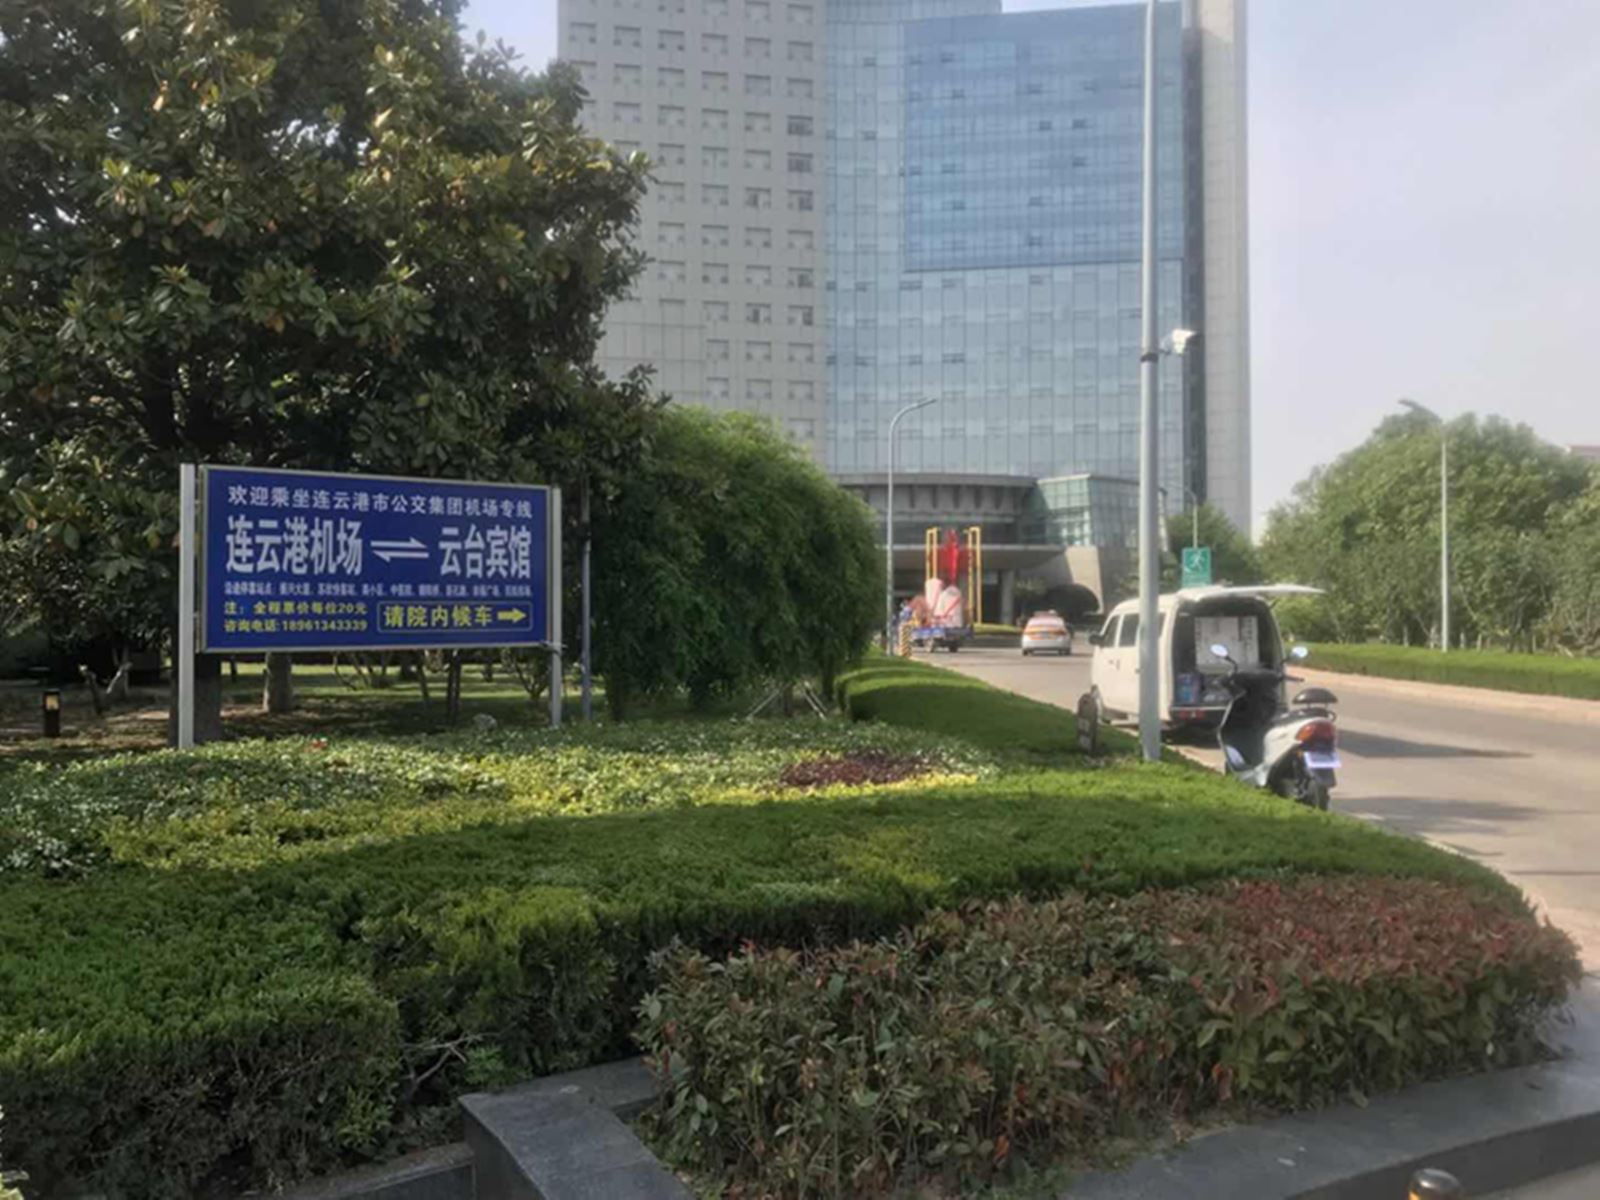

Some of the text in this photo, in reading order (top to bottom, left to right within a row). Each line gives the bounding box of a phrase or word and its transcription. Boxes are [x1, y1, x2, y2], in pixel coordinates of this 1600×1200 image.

[228, 485, 532, 518] 欢迎乘坐连云港市公交集团机场专线
[226, 514, 532, 578] 连云港机场 云台宾馆
[384, 605, 493, 627] 请院内候车
